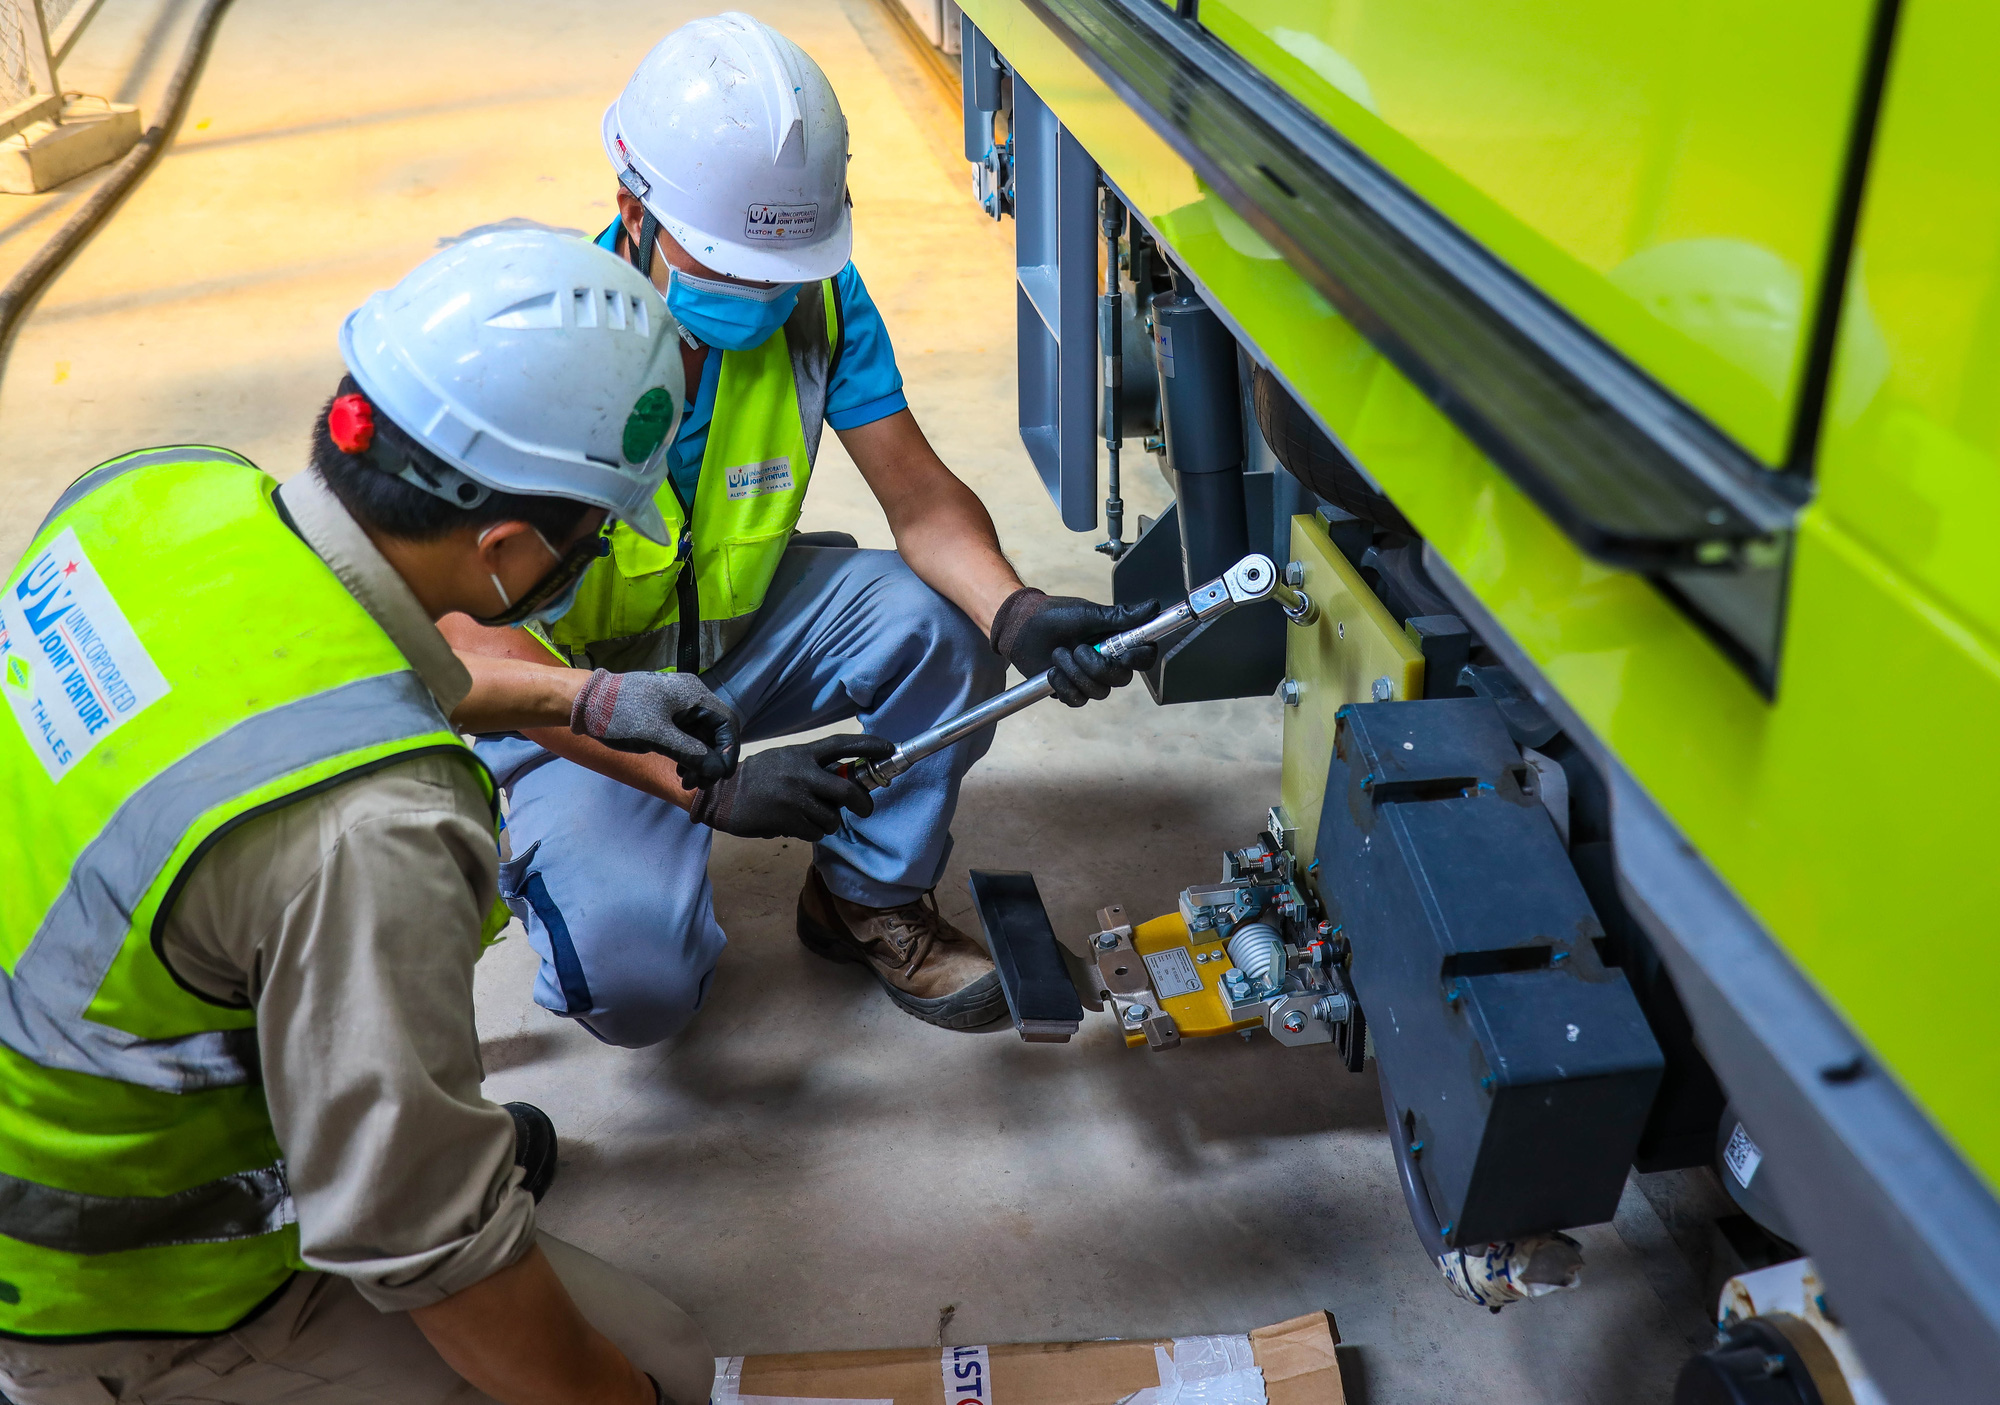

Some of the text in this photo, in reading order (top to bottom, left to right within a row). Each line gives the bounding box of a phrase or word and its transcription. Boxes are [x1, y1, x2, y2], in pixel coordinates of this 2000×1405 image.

[747, 228, 772, 236] ALSTOM
[794, 216, 815, 225] VENTURE
[749, 471, 789, 485] JOINT VENTURE
[766, 481, 792, 490] THALES
[65, 608, 136, 713] UNINCORPORATED
[39, 629, 110, 736] JOINT VENTURE
[31, 698, 72, 766] THALES
[953, 1345, 984, 1405] LST
